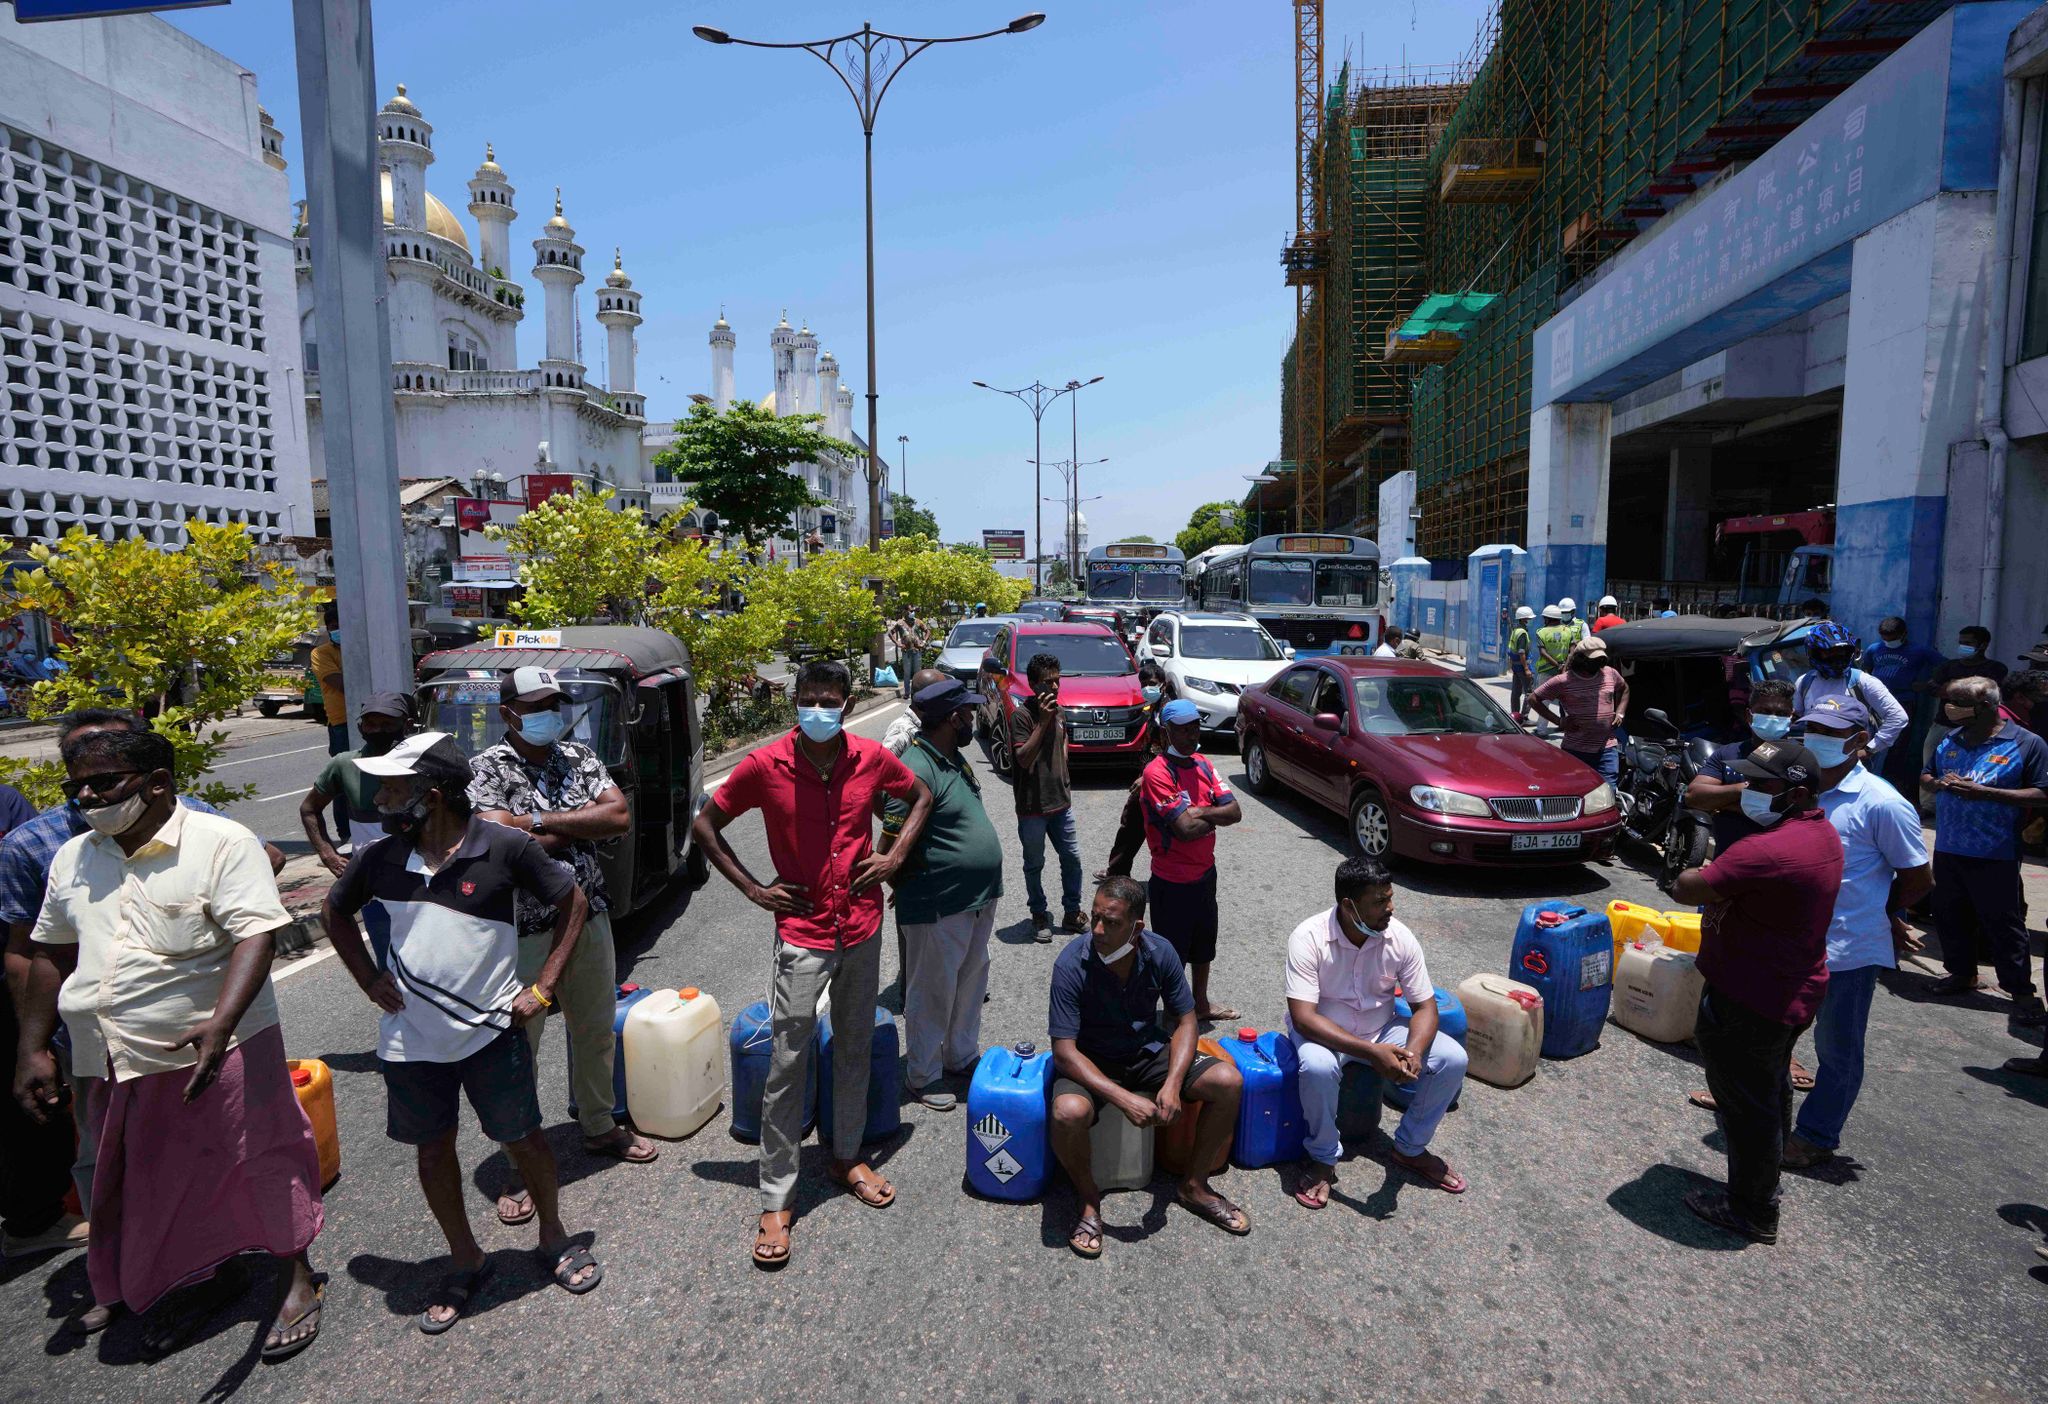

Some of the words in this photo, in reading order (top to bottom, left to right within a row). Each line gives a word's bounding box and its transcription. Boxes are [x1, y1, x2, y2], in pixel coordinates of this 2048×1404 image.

[1834, 145, 1864, 173] LTD
[1731, 231, 1807, 283] DEPARTMENT
[1815, 200, 1861, 235] STORE
[516, 633, 558, 644] PickMe
[1083, 730, 1100, 739] CBD
[1103, 729, 1124, 739] 8035
[1551, 834, 1579, 847] 1661
